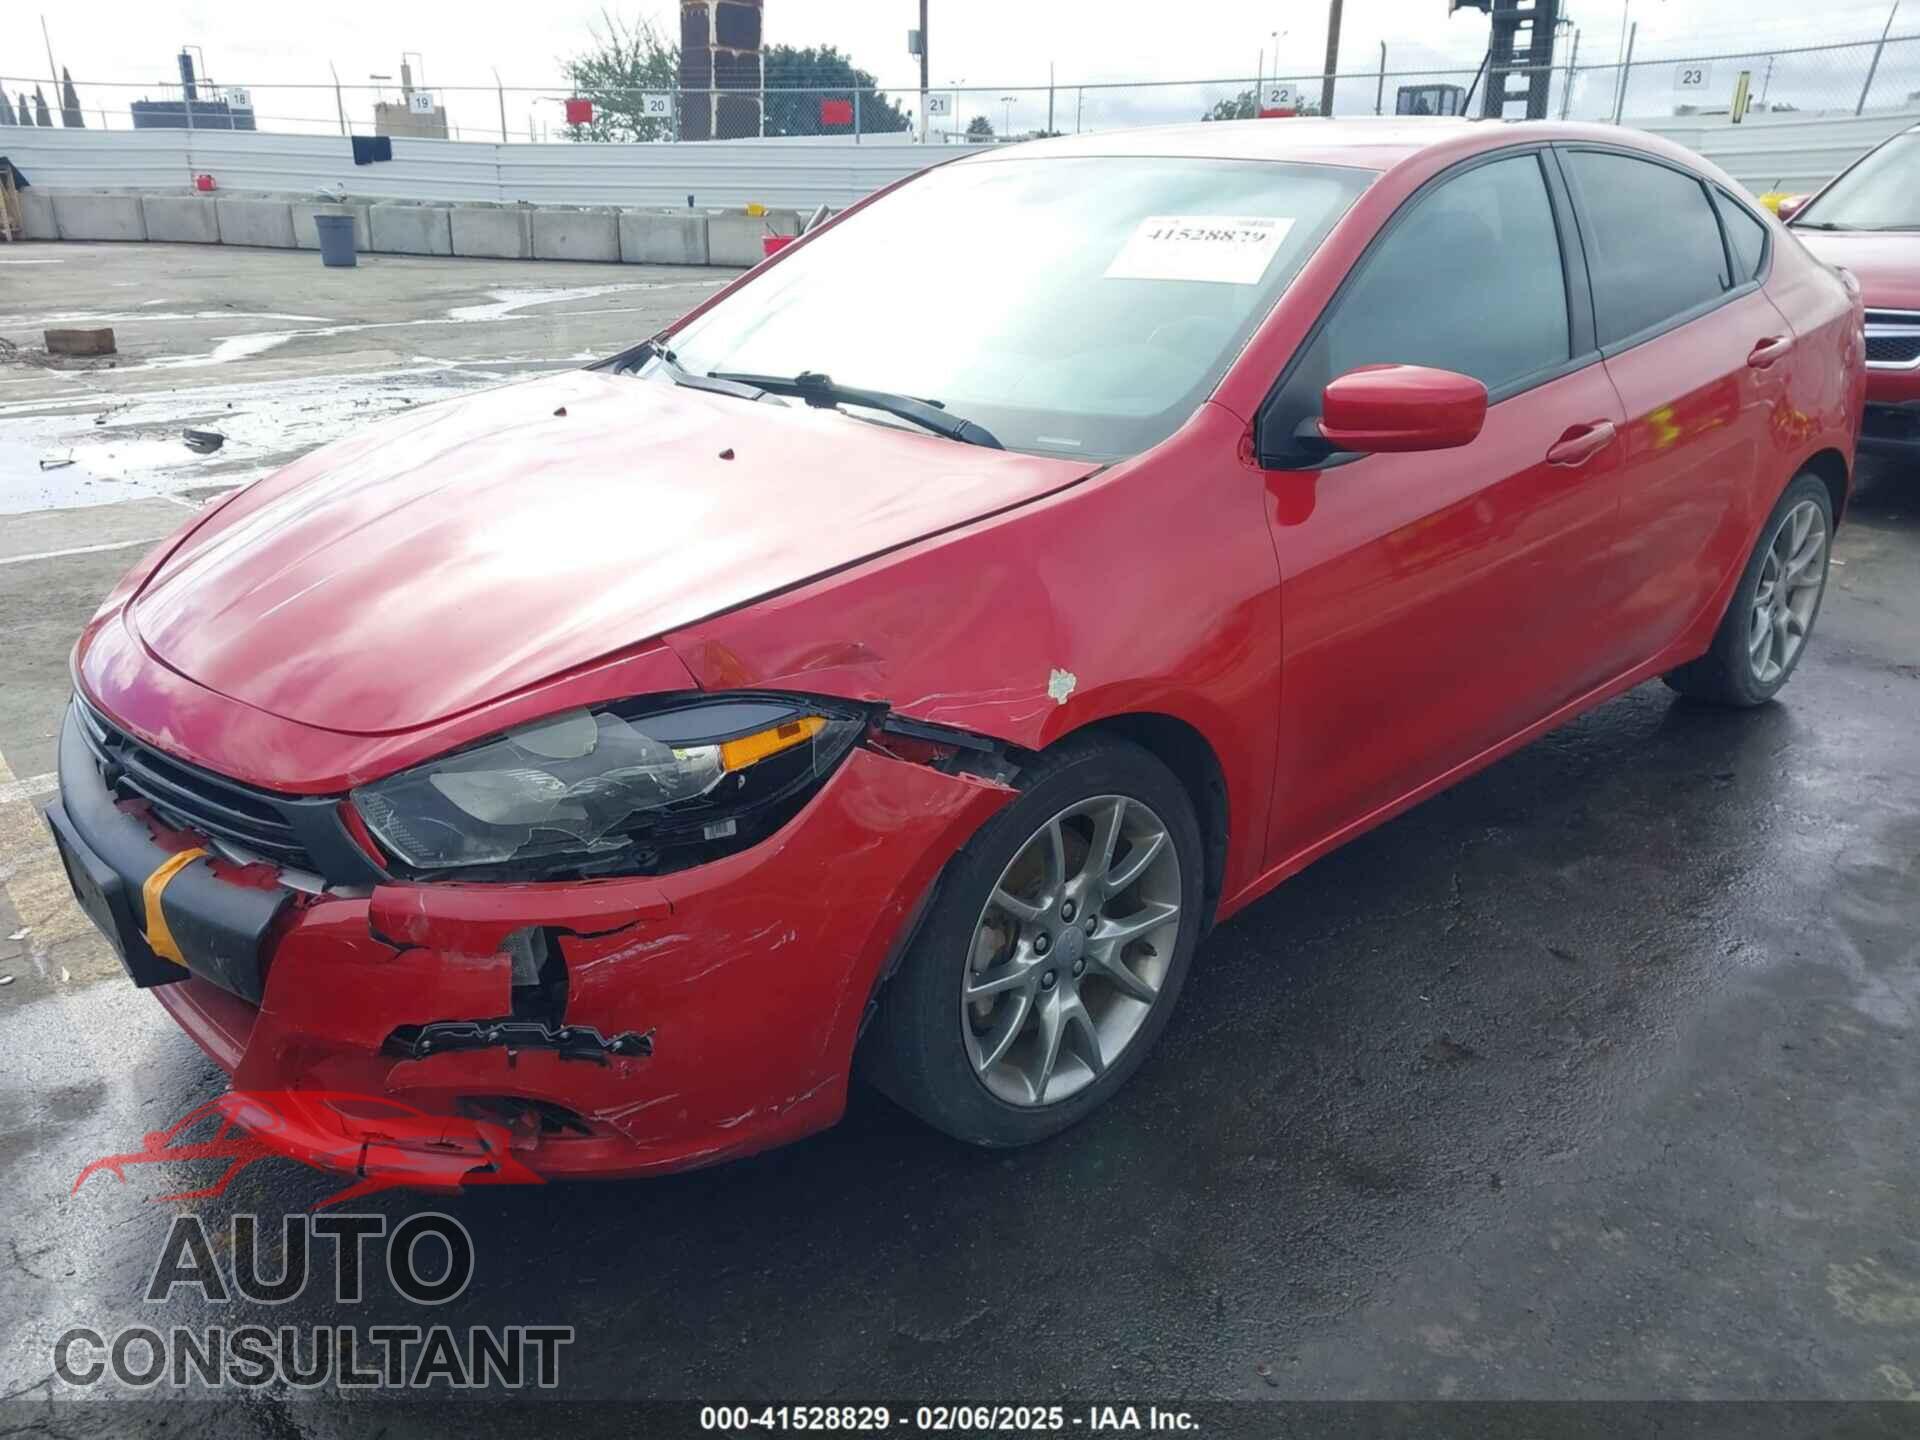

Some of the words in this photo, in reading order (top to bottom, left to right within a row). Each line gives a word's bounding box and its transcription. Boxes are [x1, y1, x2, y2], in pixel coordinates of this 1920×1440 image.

[1683, 70, 1702, 84] 23
[233, 94, 246, 105] 18
[1271, 90, 1288, 102] 22
[416, 97, 429, 109] 19
[650, 100, 665, 112] 20
[930, 98, 944, 111] 21
